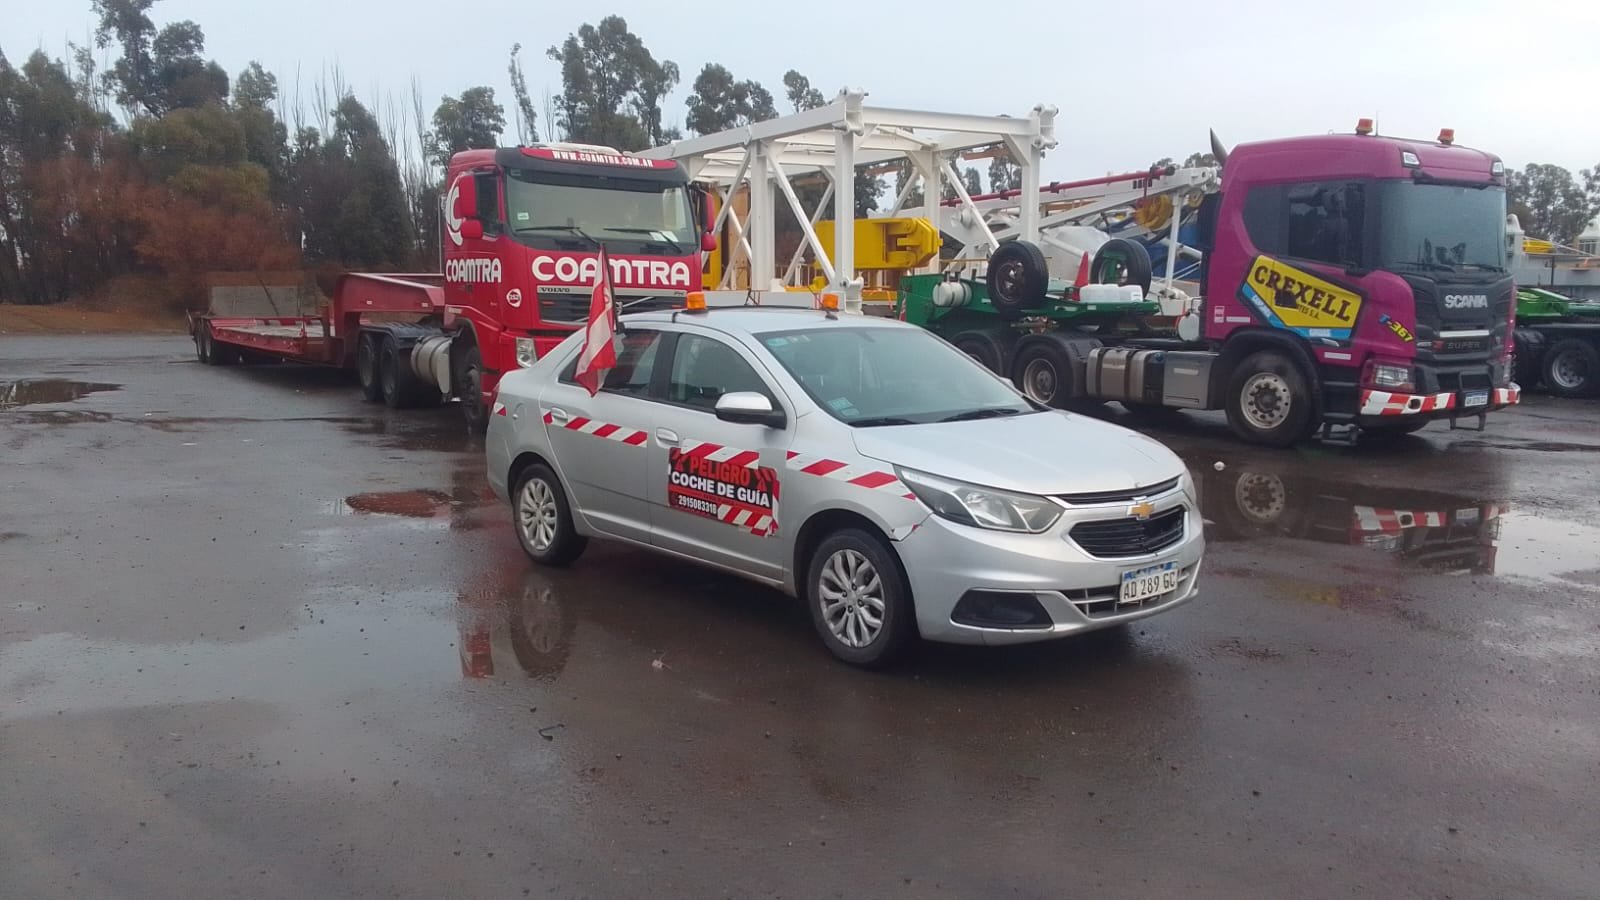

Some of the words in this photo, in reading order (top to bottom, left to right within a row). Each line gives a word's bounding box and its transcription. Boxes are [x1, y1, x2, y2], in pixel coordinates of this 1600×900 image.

[446, 258, 502, 283] COAMTRA
[531, 255, 691, 287] COAMTRA
[1254, 265, 1352, 322] CREXELL
[1444, 294, 1489, 309] SCANIA
[1379, 313, 1415, 342] T-367
[690, 455, 751, 487] PELIGRO
[671, 471, 715, 494] COCHE
[717, 482, 735, 499] DE
[737, 487, 770, 508] GUÍA
[1123, 581, 1137, 599] AD
[1140, 575, 1160, 596] 289
[1163, 571, 1176, 589] GC
